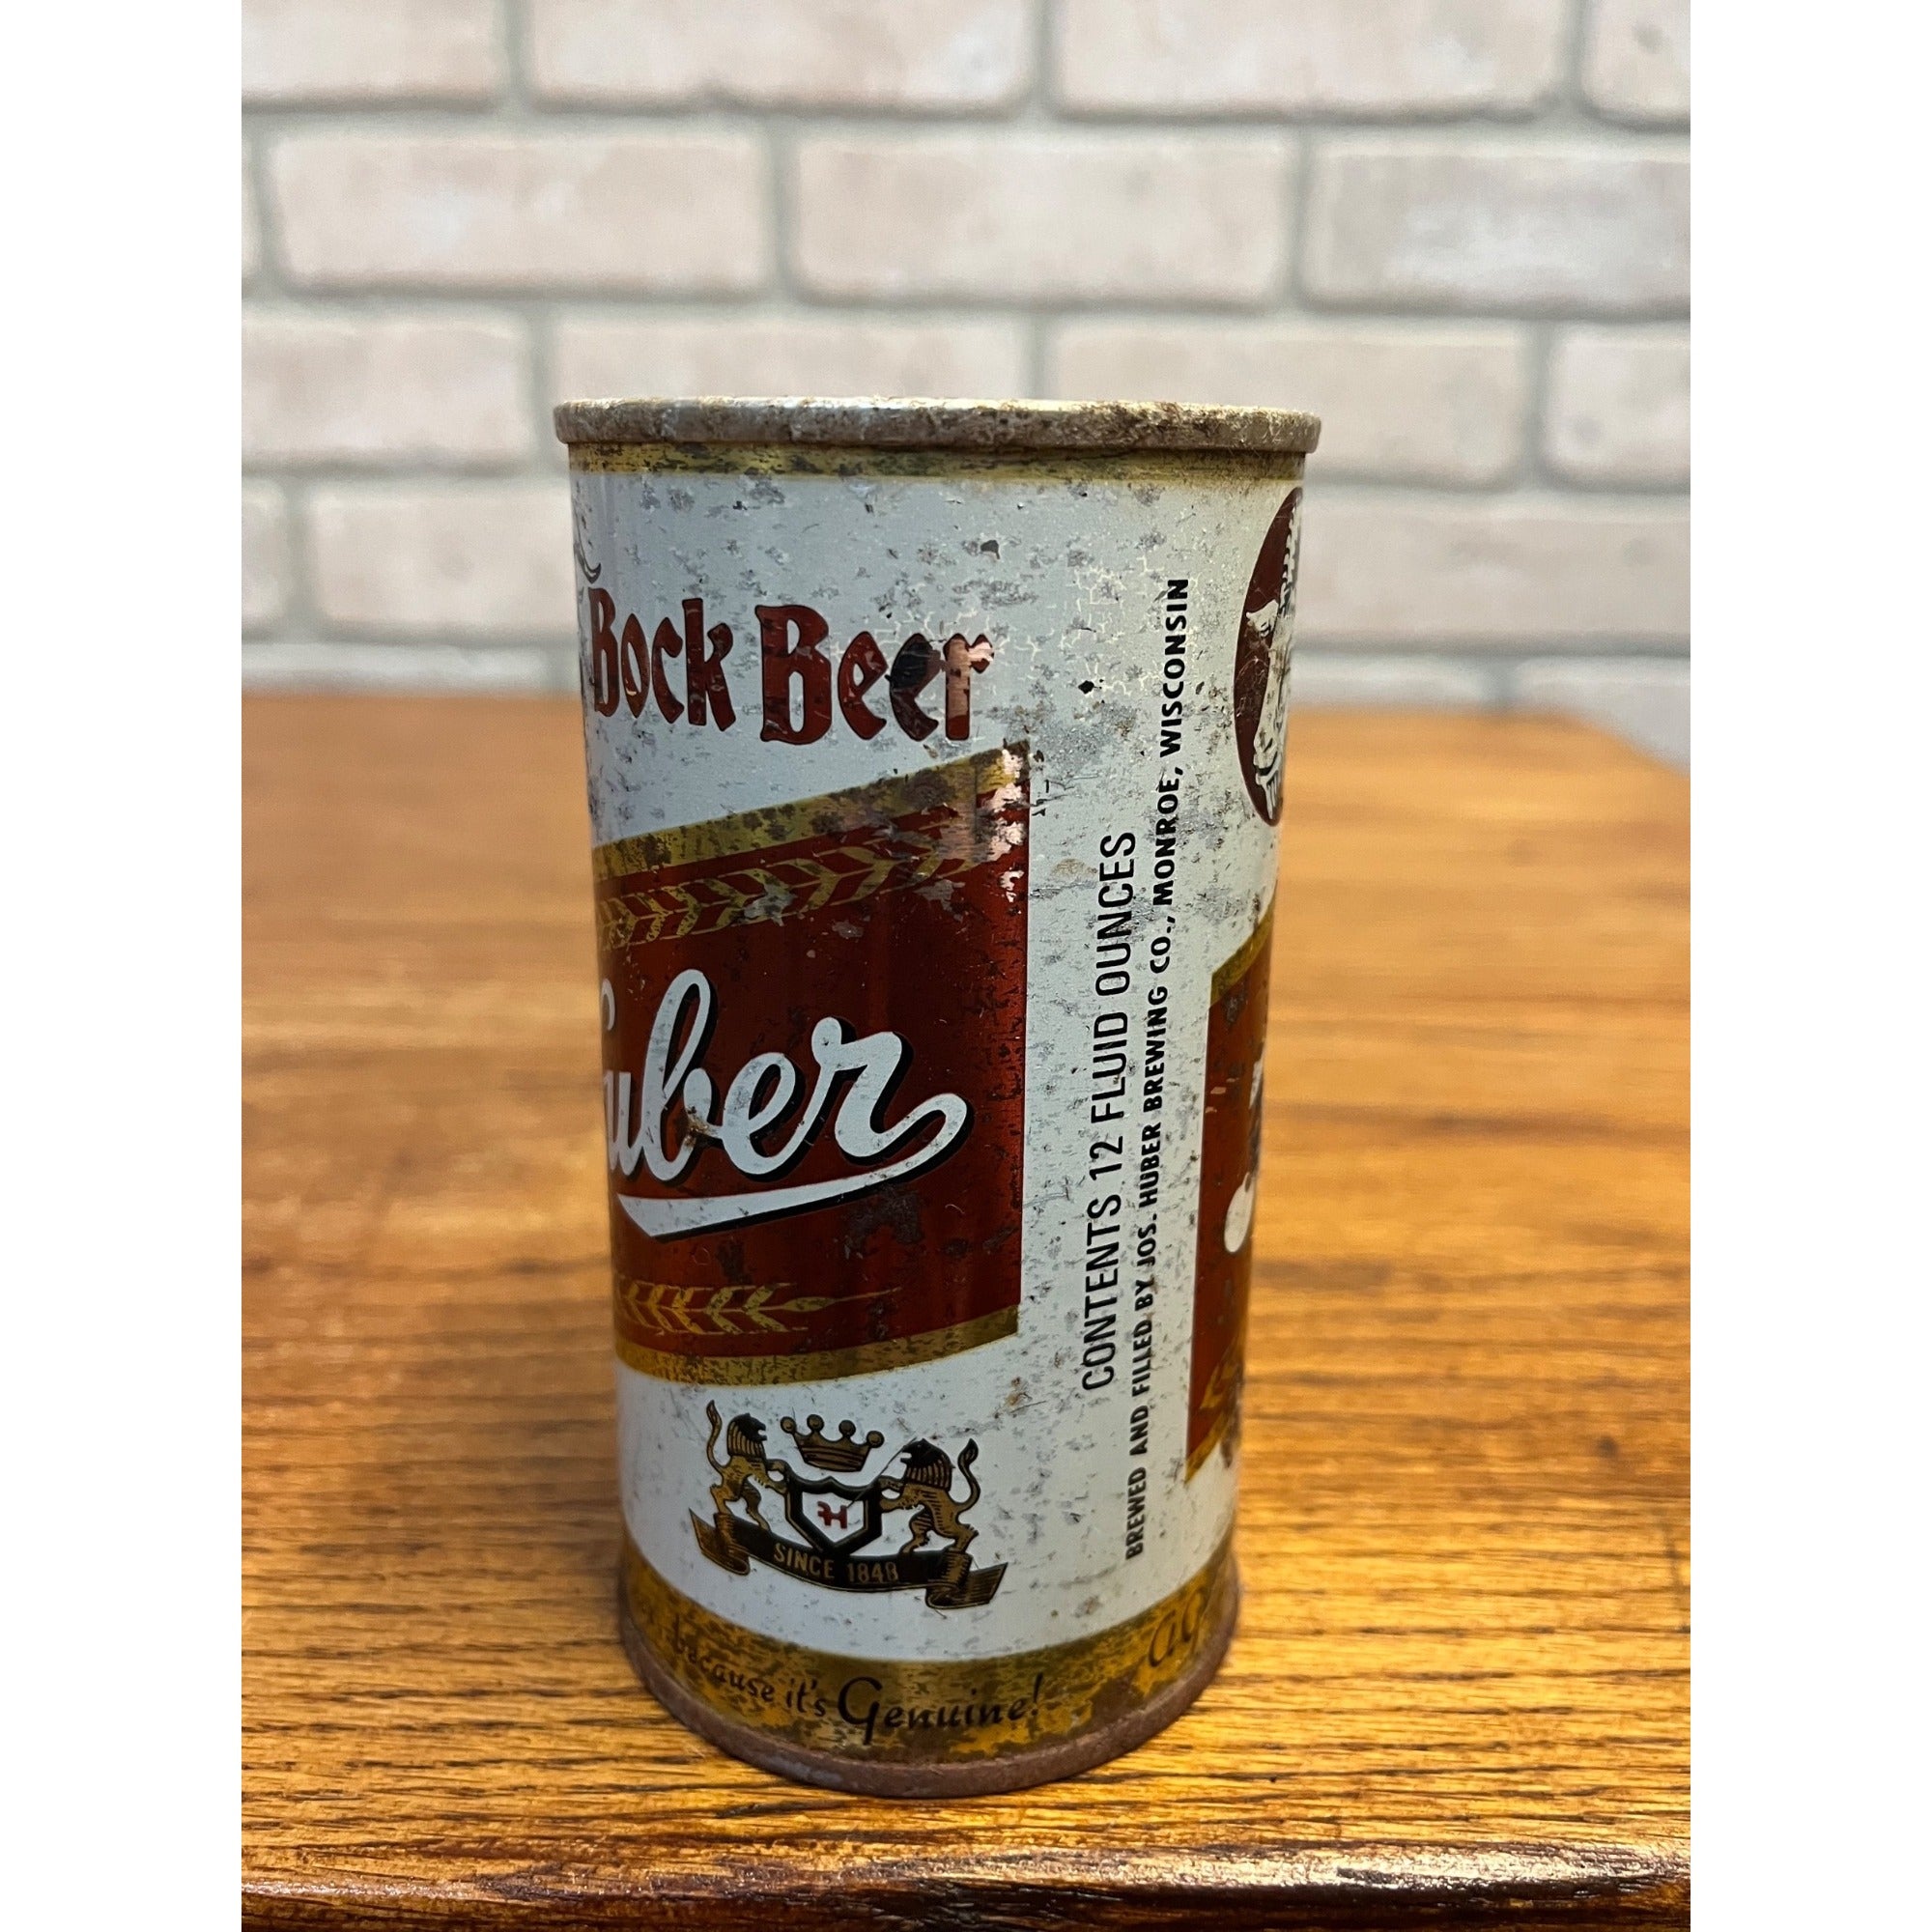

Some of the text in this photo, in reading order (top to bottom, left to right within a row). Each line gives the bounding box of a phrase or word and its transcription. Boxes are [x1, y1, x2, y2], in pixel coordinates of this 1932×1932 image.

[588, 587, 995, 746] Bock Beer
[601, 968, 968, 1236] uber
[1081, 832, 1136, 1391] CONTENTS 12 FLUID OUNCES
[1125, 579, 1189, 1560] BREWED AND FILLED BY JOS. HUBER BREWING CO., MONROE, WISCONSIN
[774, 1543, 899, 1584] SINCE 1848
[785, 1677, 827, 1717] it's
[838, 1671, 1044, 1746] Genuine!
